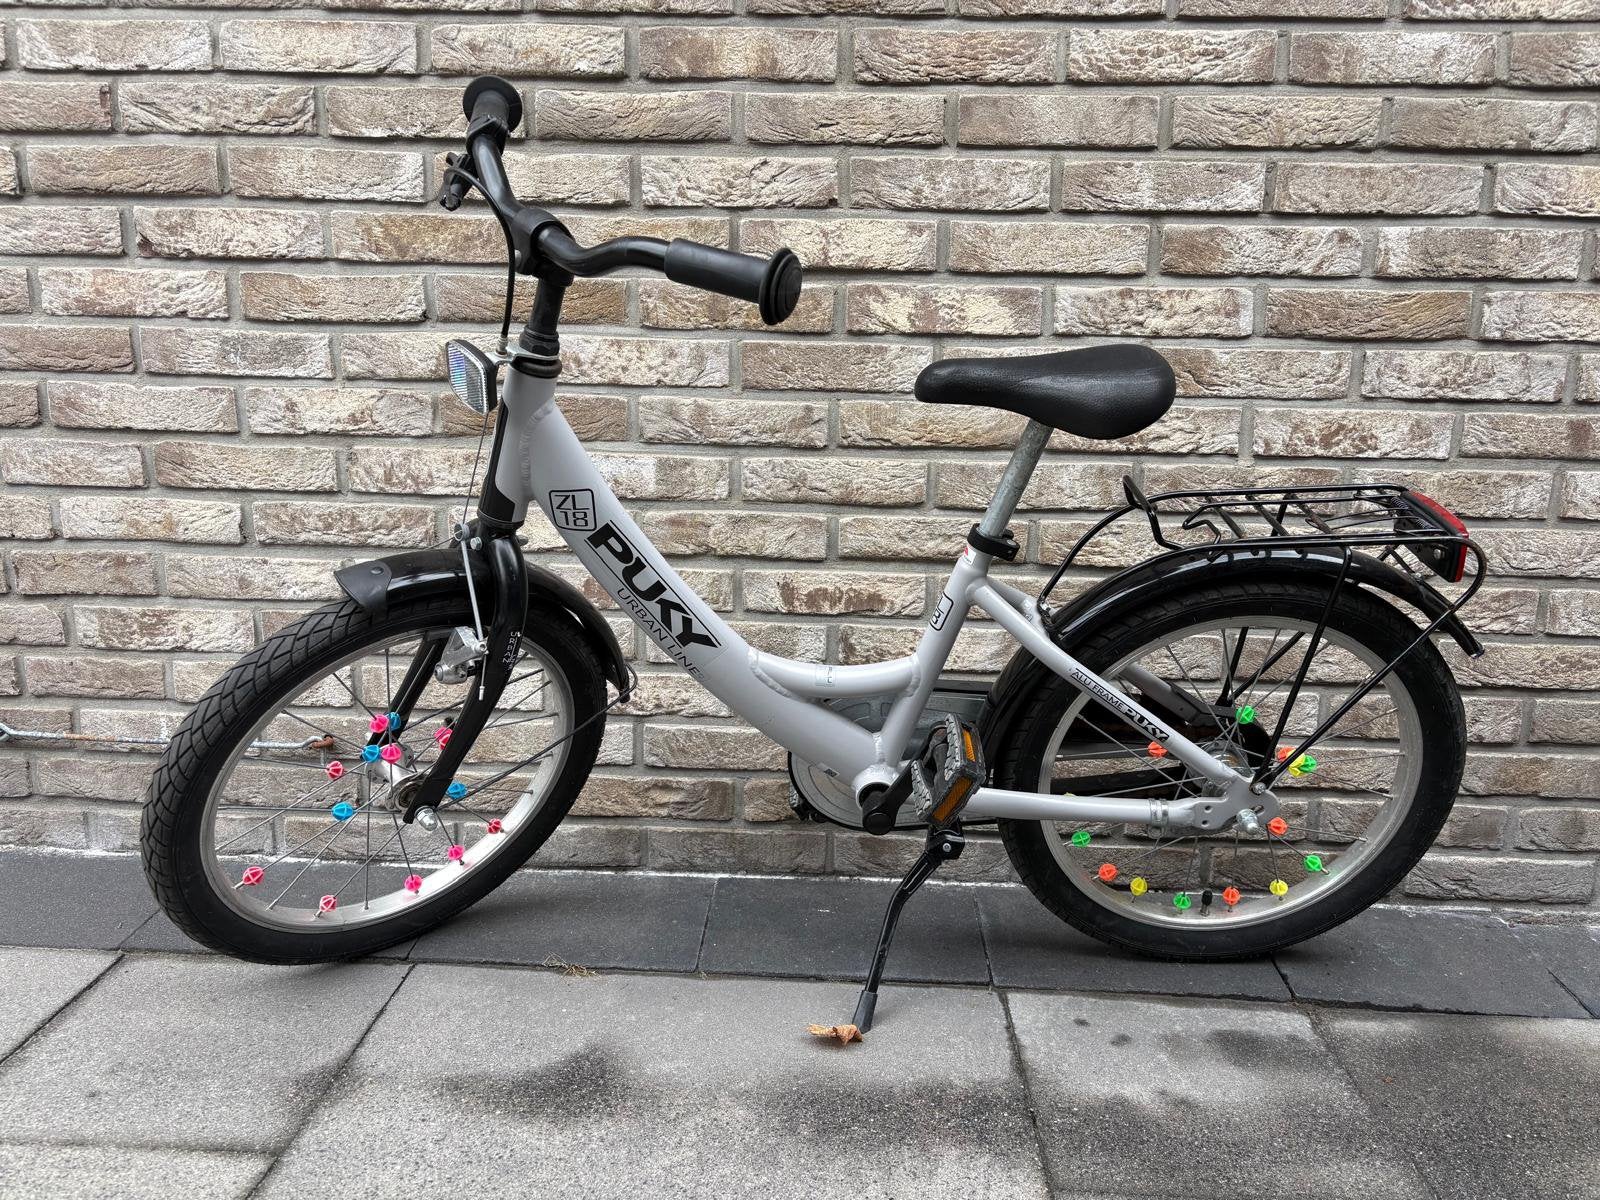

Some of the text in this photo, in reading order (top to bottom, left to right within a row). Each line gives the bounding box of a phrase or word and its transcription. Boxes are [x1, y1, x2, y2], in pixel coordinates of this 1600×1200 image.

[554, 494, 590, 511] ZL
[559, 510, 589, 527] 18
[586, 522, 719, 649] PUKY
[616, 587, 701, 676] URBAN LINE
[1071, 671, 1170, 742] ALU FRAME PUKY
